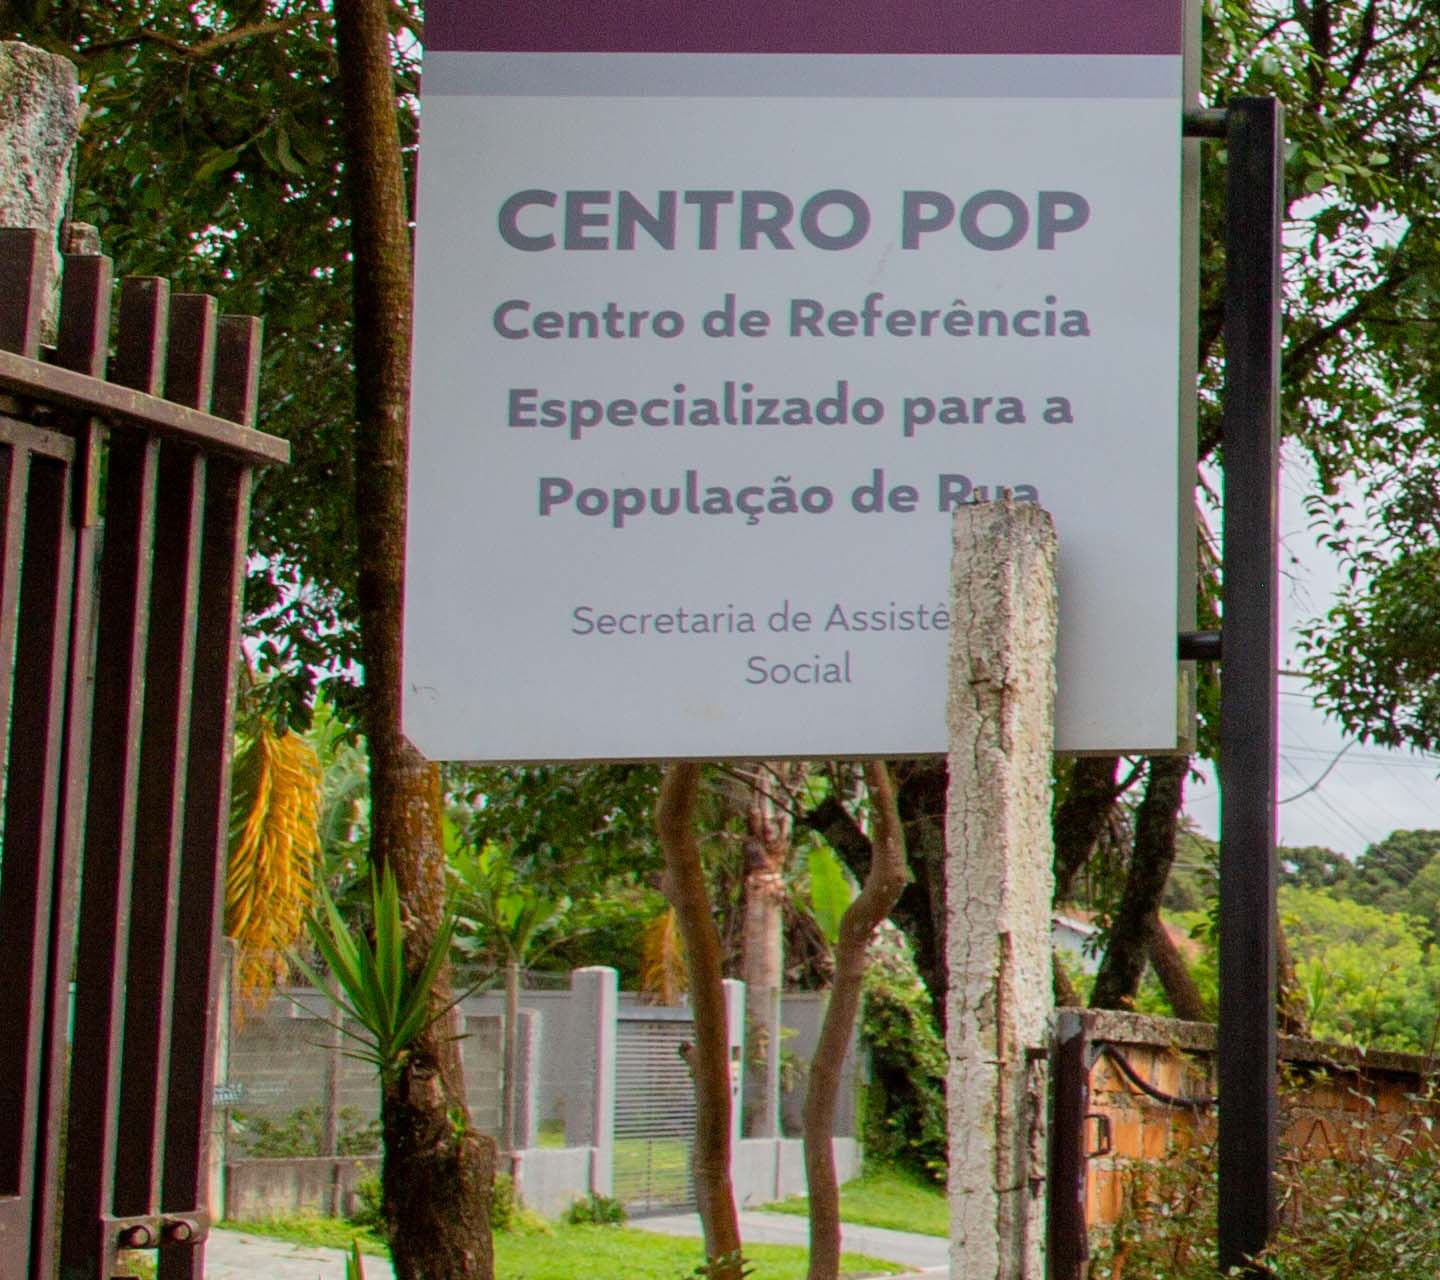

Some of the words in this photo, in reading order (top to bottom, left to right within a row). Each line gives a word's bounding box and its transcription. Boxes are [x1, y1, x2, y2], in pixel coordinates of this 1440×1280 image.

[498, 188, 872, 254] CENTRO
[902, 190, 1091, 252] POP
[493, 299, 686, 342] Centro
[702, 294, 772, 340] de
[790, 292, 1092, 339] Referência
[508, 381, 886, 442] Especializado
[903, 396, 1027, 438] para
[1043, 397, 1075, 426] a
[538, 470, 835, 530] População
[851, 469, 921, 515] de
[571, 602, 757, 637] Secretaria
[768, 600, 814, 634] de
[824, 601, 950, 633] Assistê
[745, 650, 853, 687] Social
